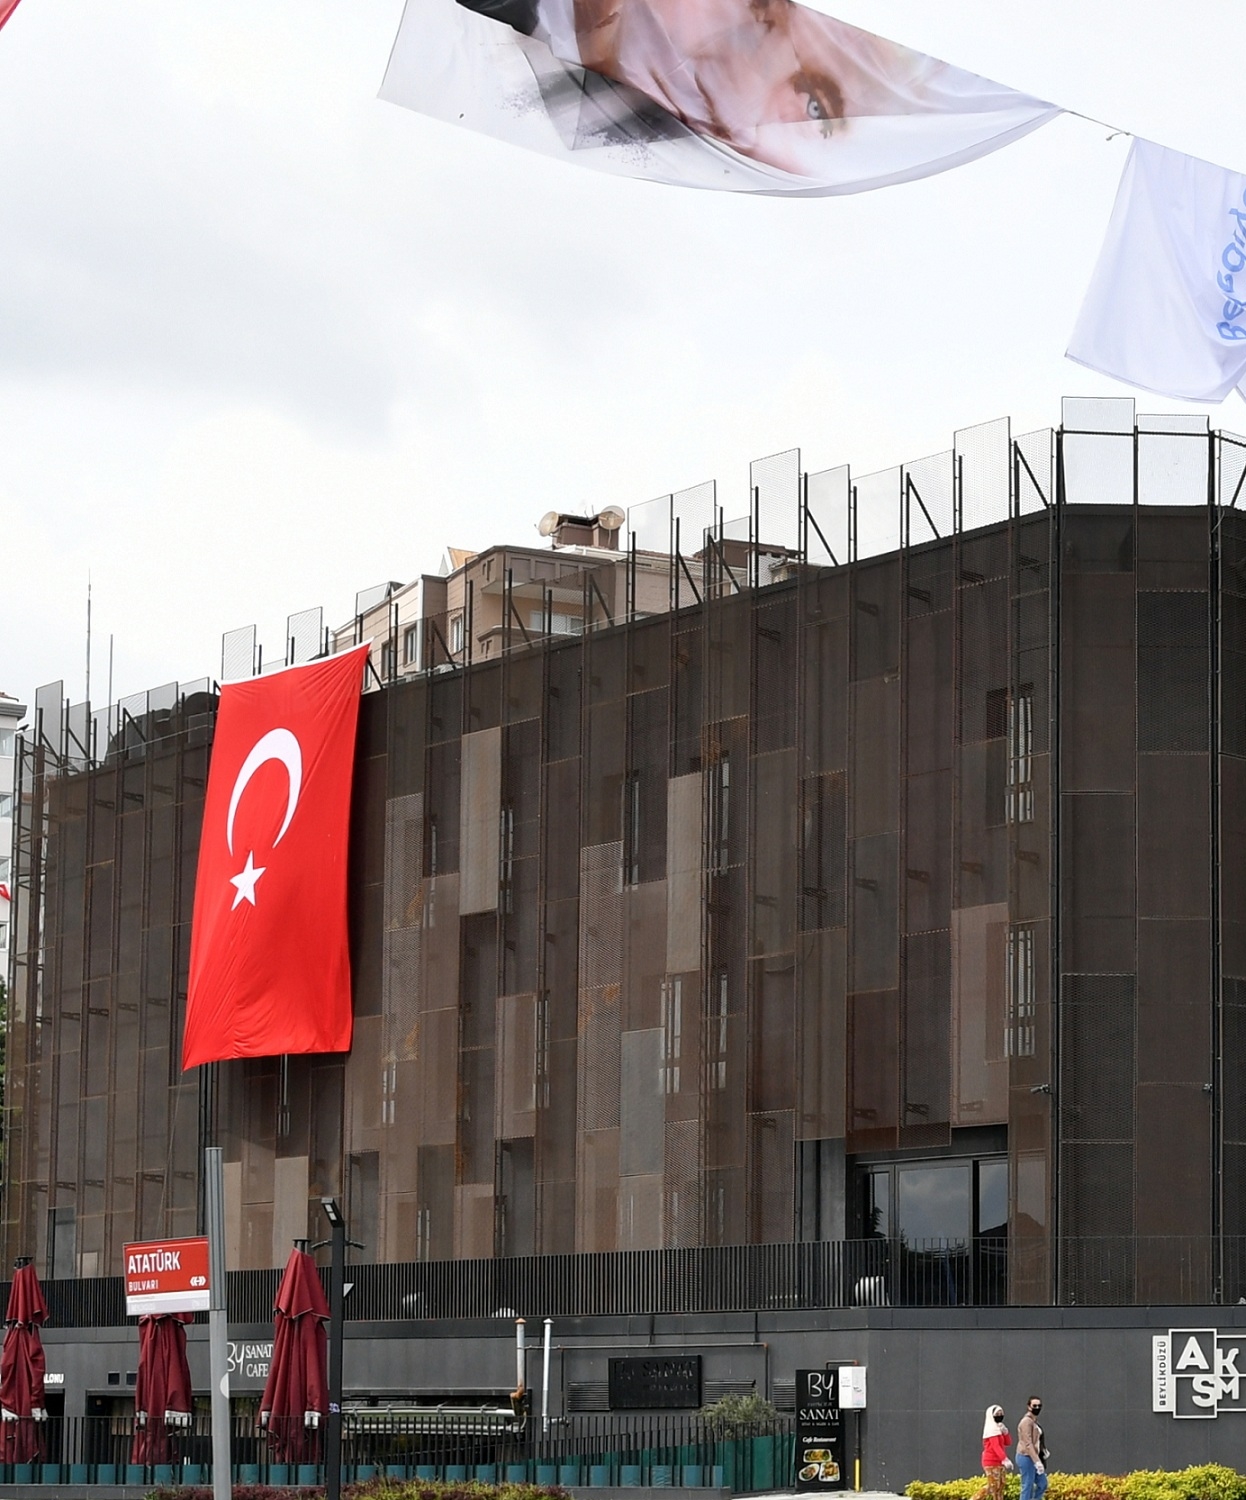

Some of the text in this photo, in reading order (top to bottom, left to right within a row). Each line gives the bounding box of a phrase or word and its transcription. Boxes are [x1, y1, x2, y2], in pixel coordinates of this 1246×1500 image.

[128, 1249, 181, 1274] ATATÜRK
[128, 1280, 159, 1292] BULVARI
[245, 1344, 274, 1359] SANAT
[246, 1363, 269, 1378] CAFE
[1157, 1341, 1167, 1406] BEYLİKDÜZÜ
[799, 1408, 841, 1421] SANAT
